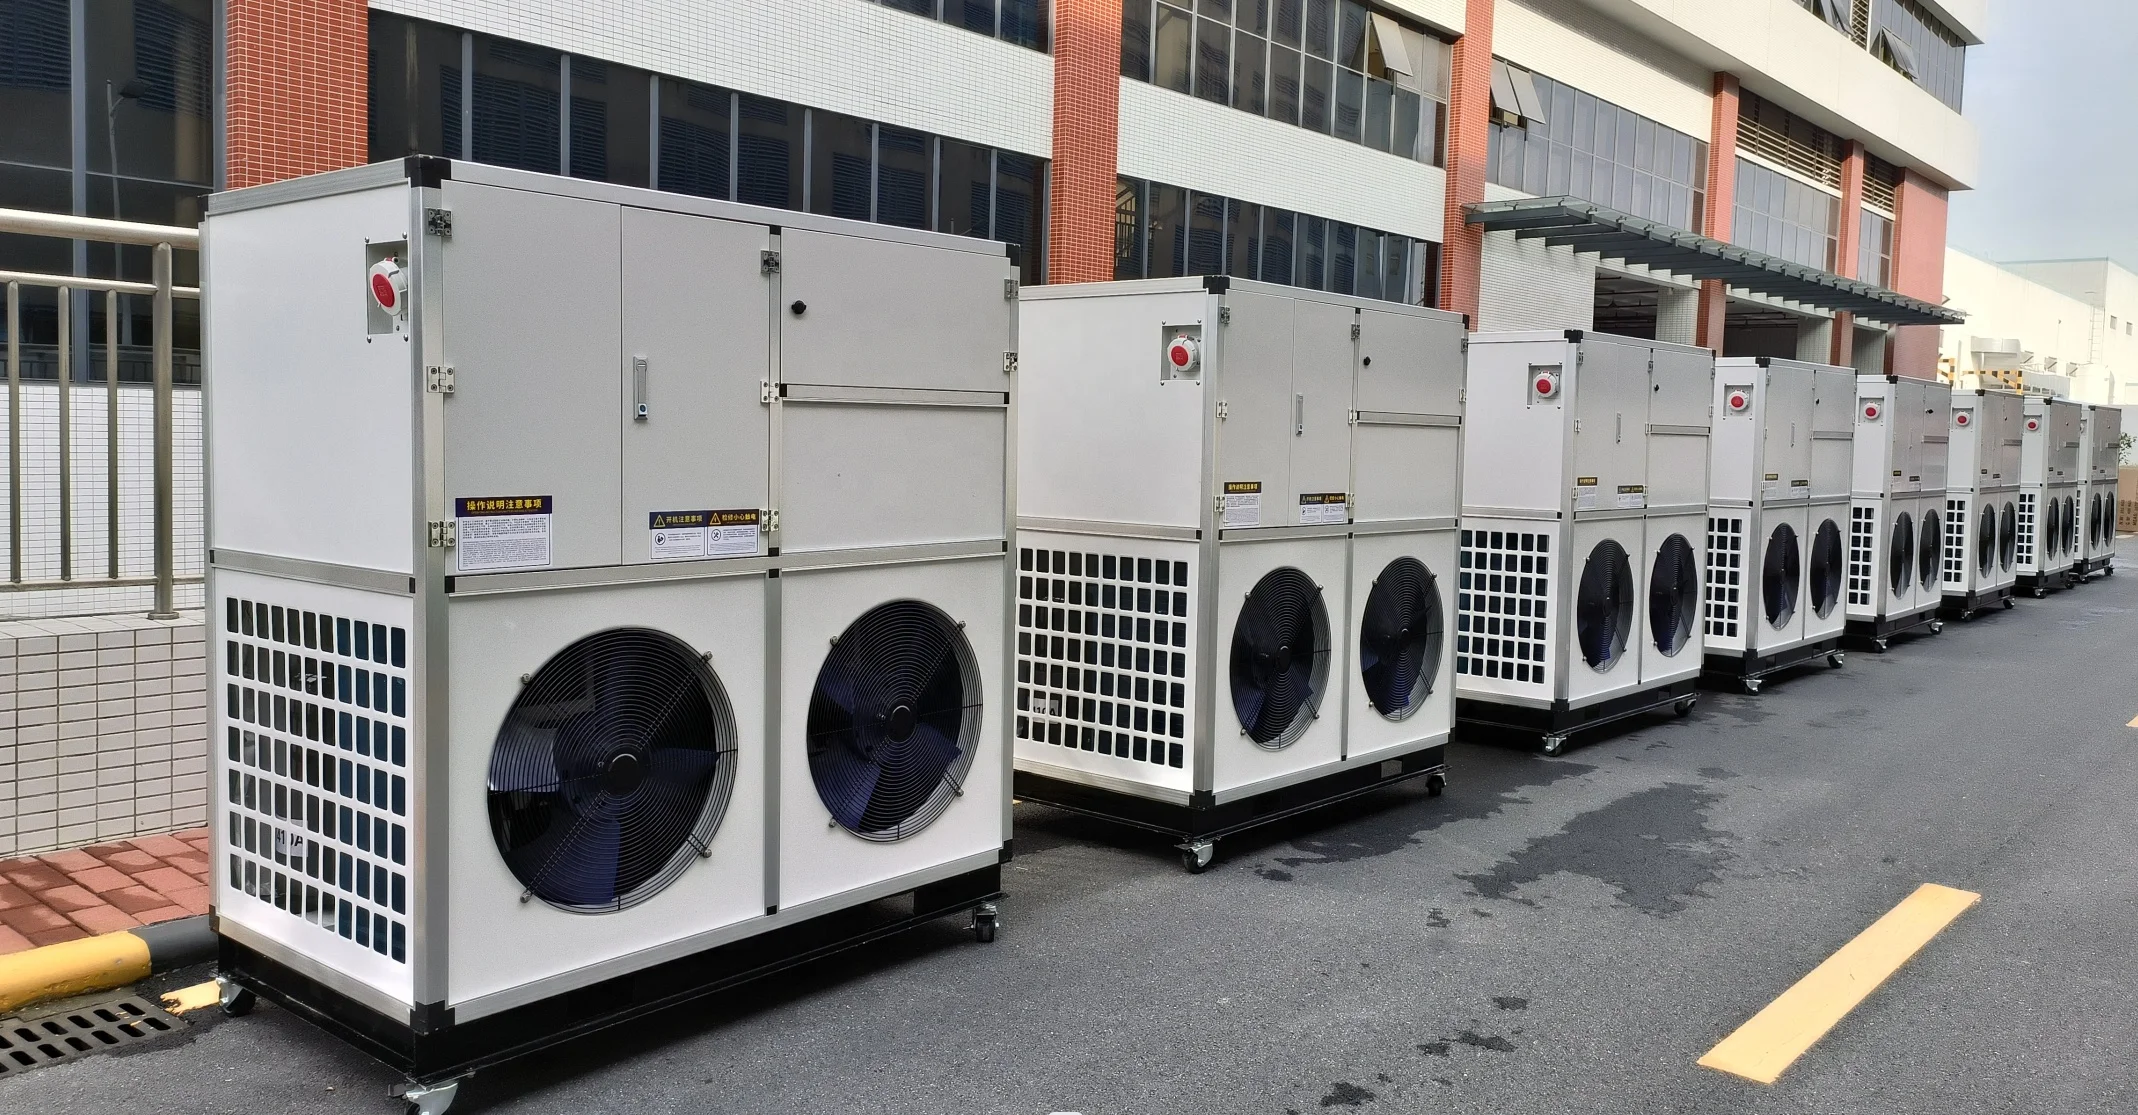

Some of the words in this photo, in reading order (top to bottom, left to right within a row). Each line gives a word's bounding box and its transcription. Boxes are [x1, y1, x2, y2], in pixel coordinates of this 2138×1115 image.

[467, 498, 542, 511] 操作说明注意事项
